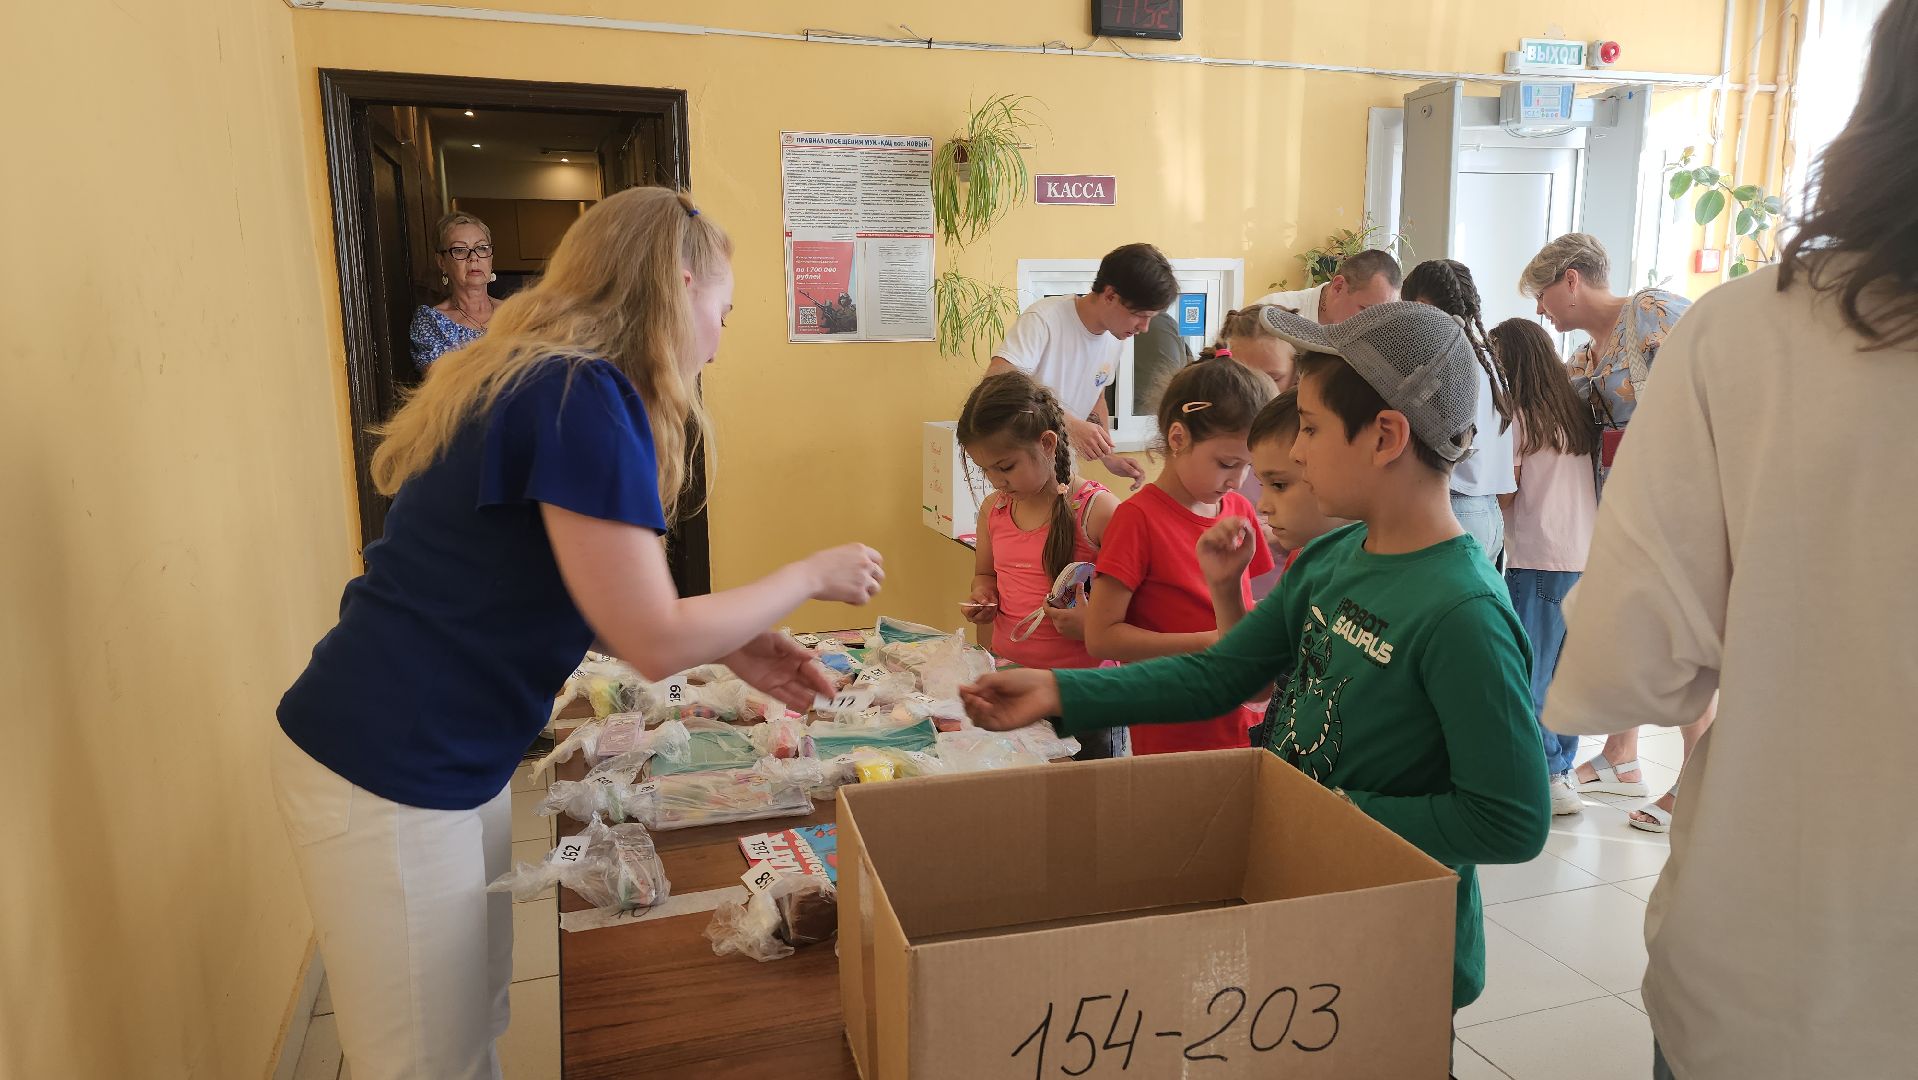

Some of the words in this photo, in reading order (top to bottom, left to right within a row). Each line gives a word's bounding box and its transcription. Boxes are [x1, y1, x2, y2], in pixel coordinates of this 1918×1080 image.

[1527, 44, 1580, 65] ВЫХОД
[825, 138, 863, 146] ПОСЕЩЕНИЯ
[1046, 182, 1106, 199] КАССА
[1343, 598, 1389, 637] ROBOT
[1332, 615, 1394, 664] SAURUS
[561, 845, 581, 862] 162
[1011, 983, 1341, 1080] 154-203
